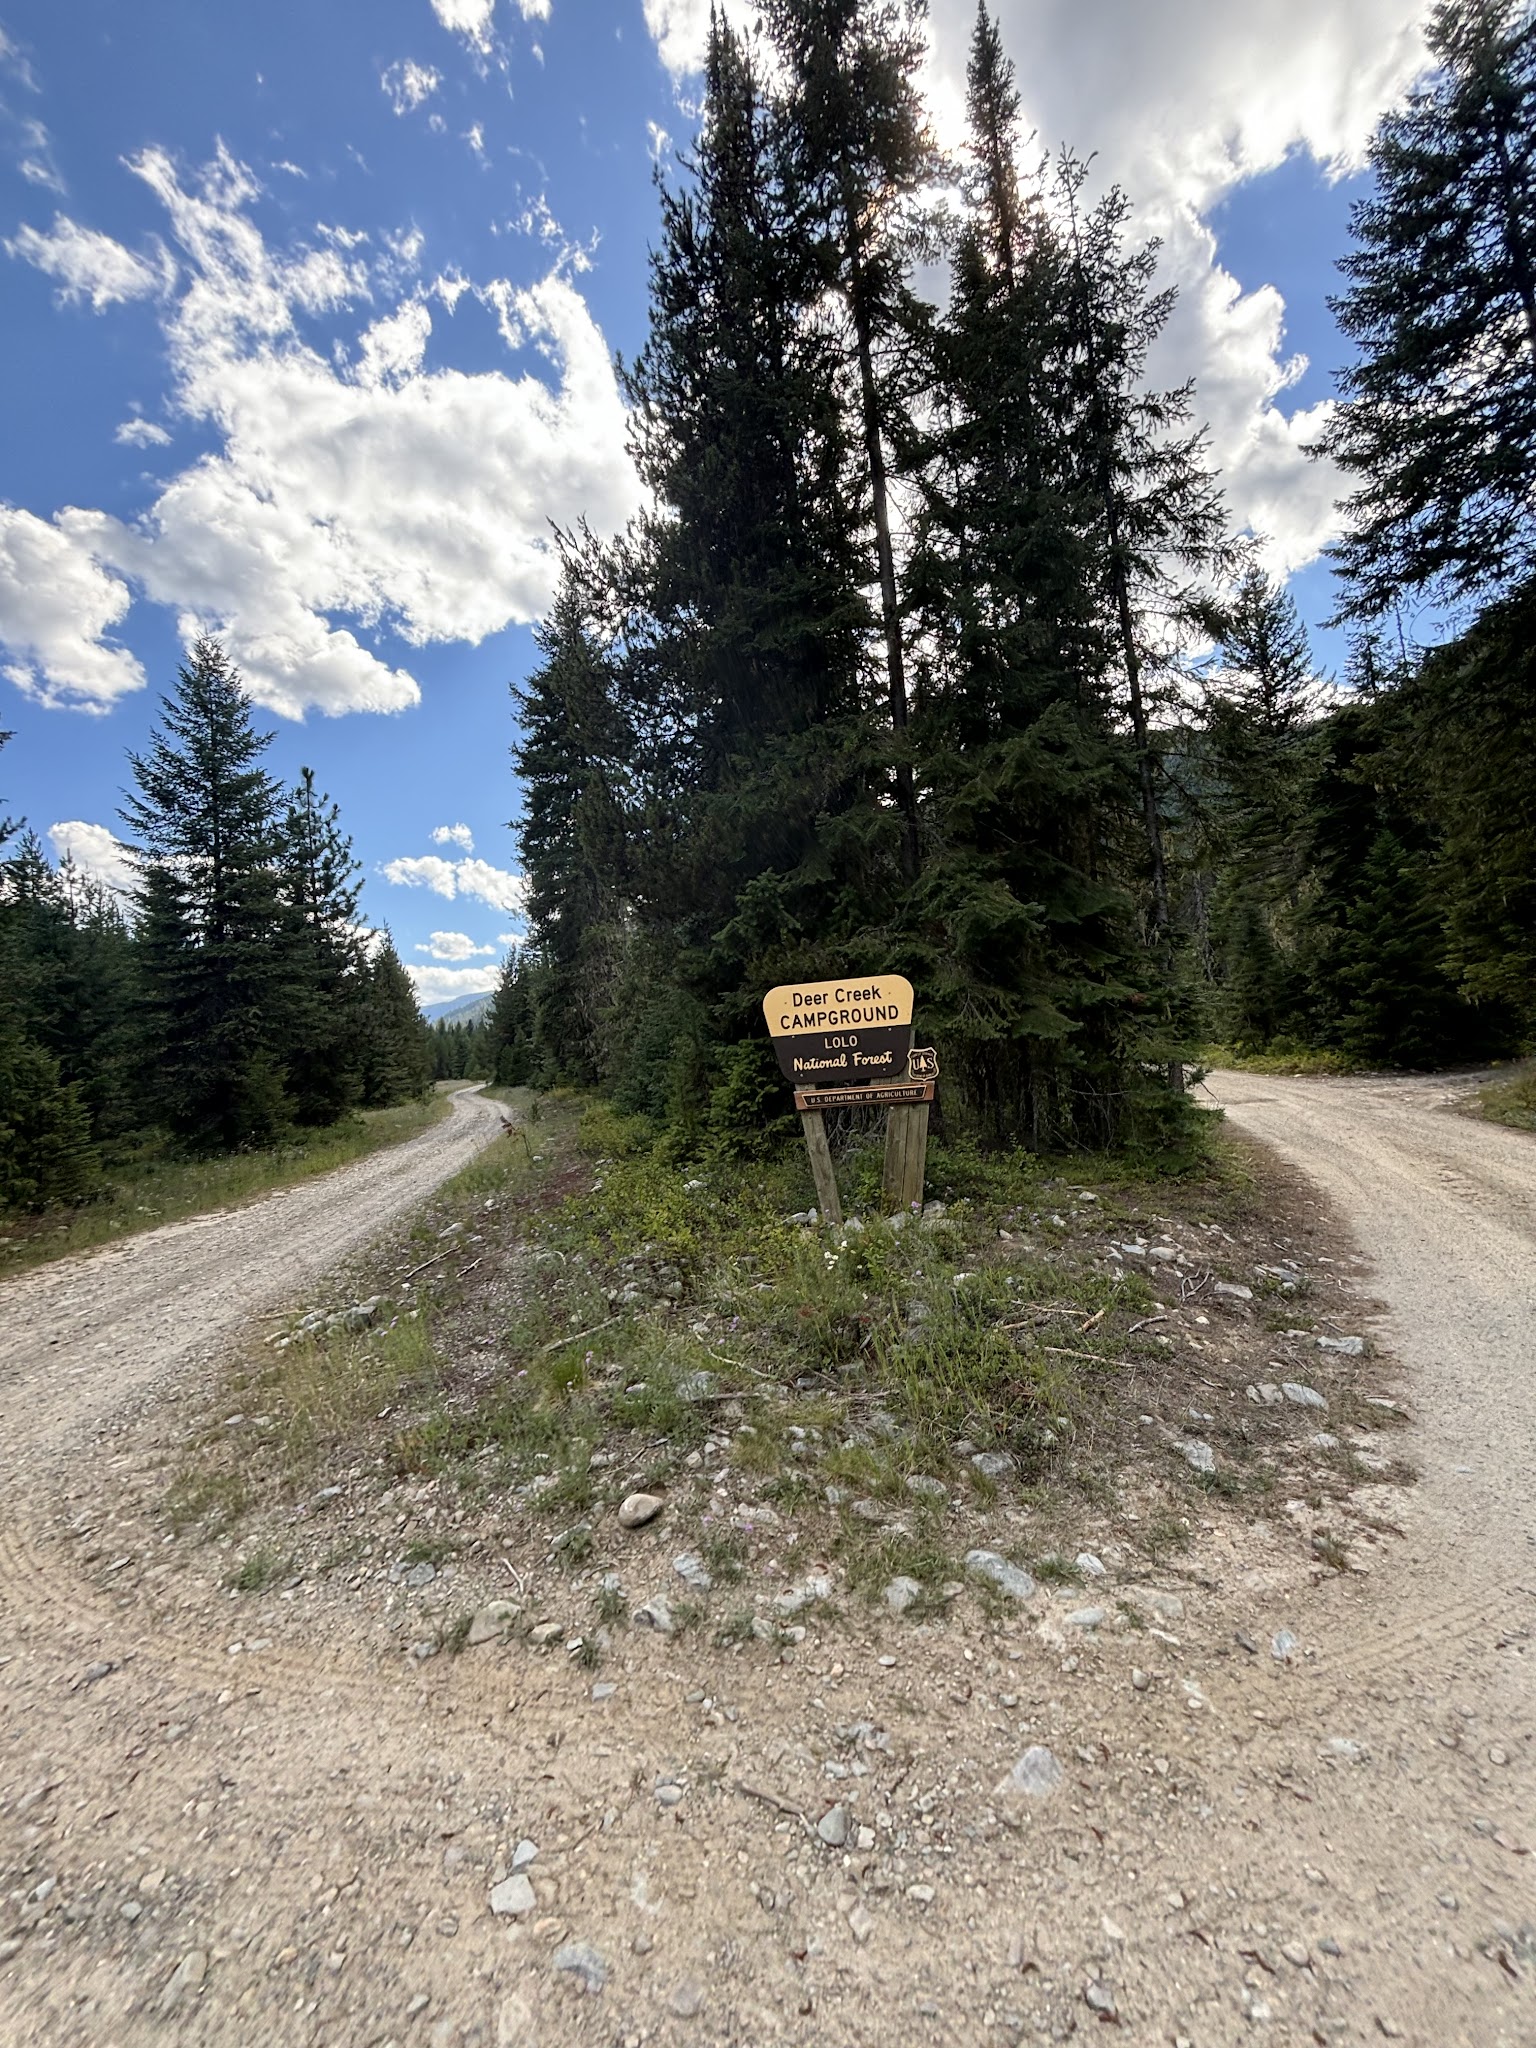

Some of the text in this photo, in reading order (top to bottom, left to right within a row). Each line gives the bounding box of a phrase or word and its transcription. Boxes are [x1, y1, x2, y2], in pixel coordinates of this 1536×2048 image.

[792, 985, 882, 1007] Deer Creek
[780, 1005, 899, 1029] CAMPGROUND
[824, 1035, 858, 1049] LOLO
[793, 1050, 893, 1072] National Forest
[824, 1093, 863, 1103] DEPARTMENT
[876, 1089, 918, 1099] AGRICULTURE
